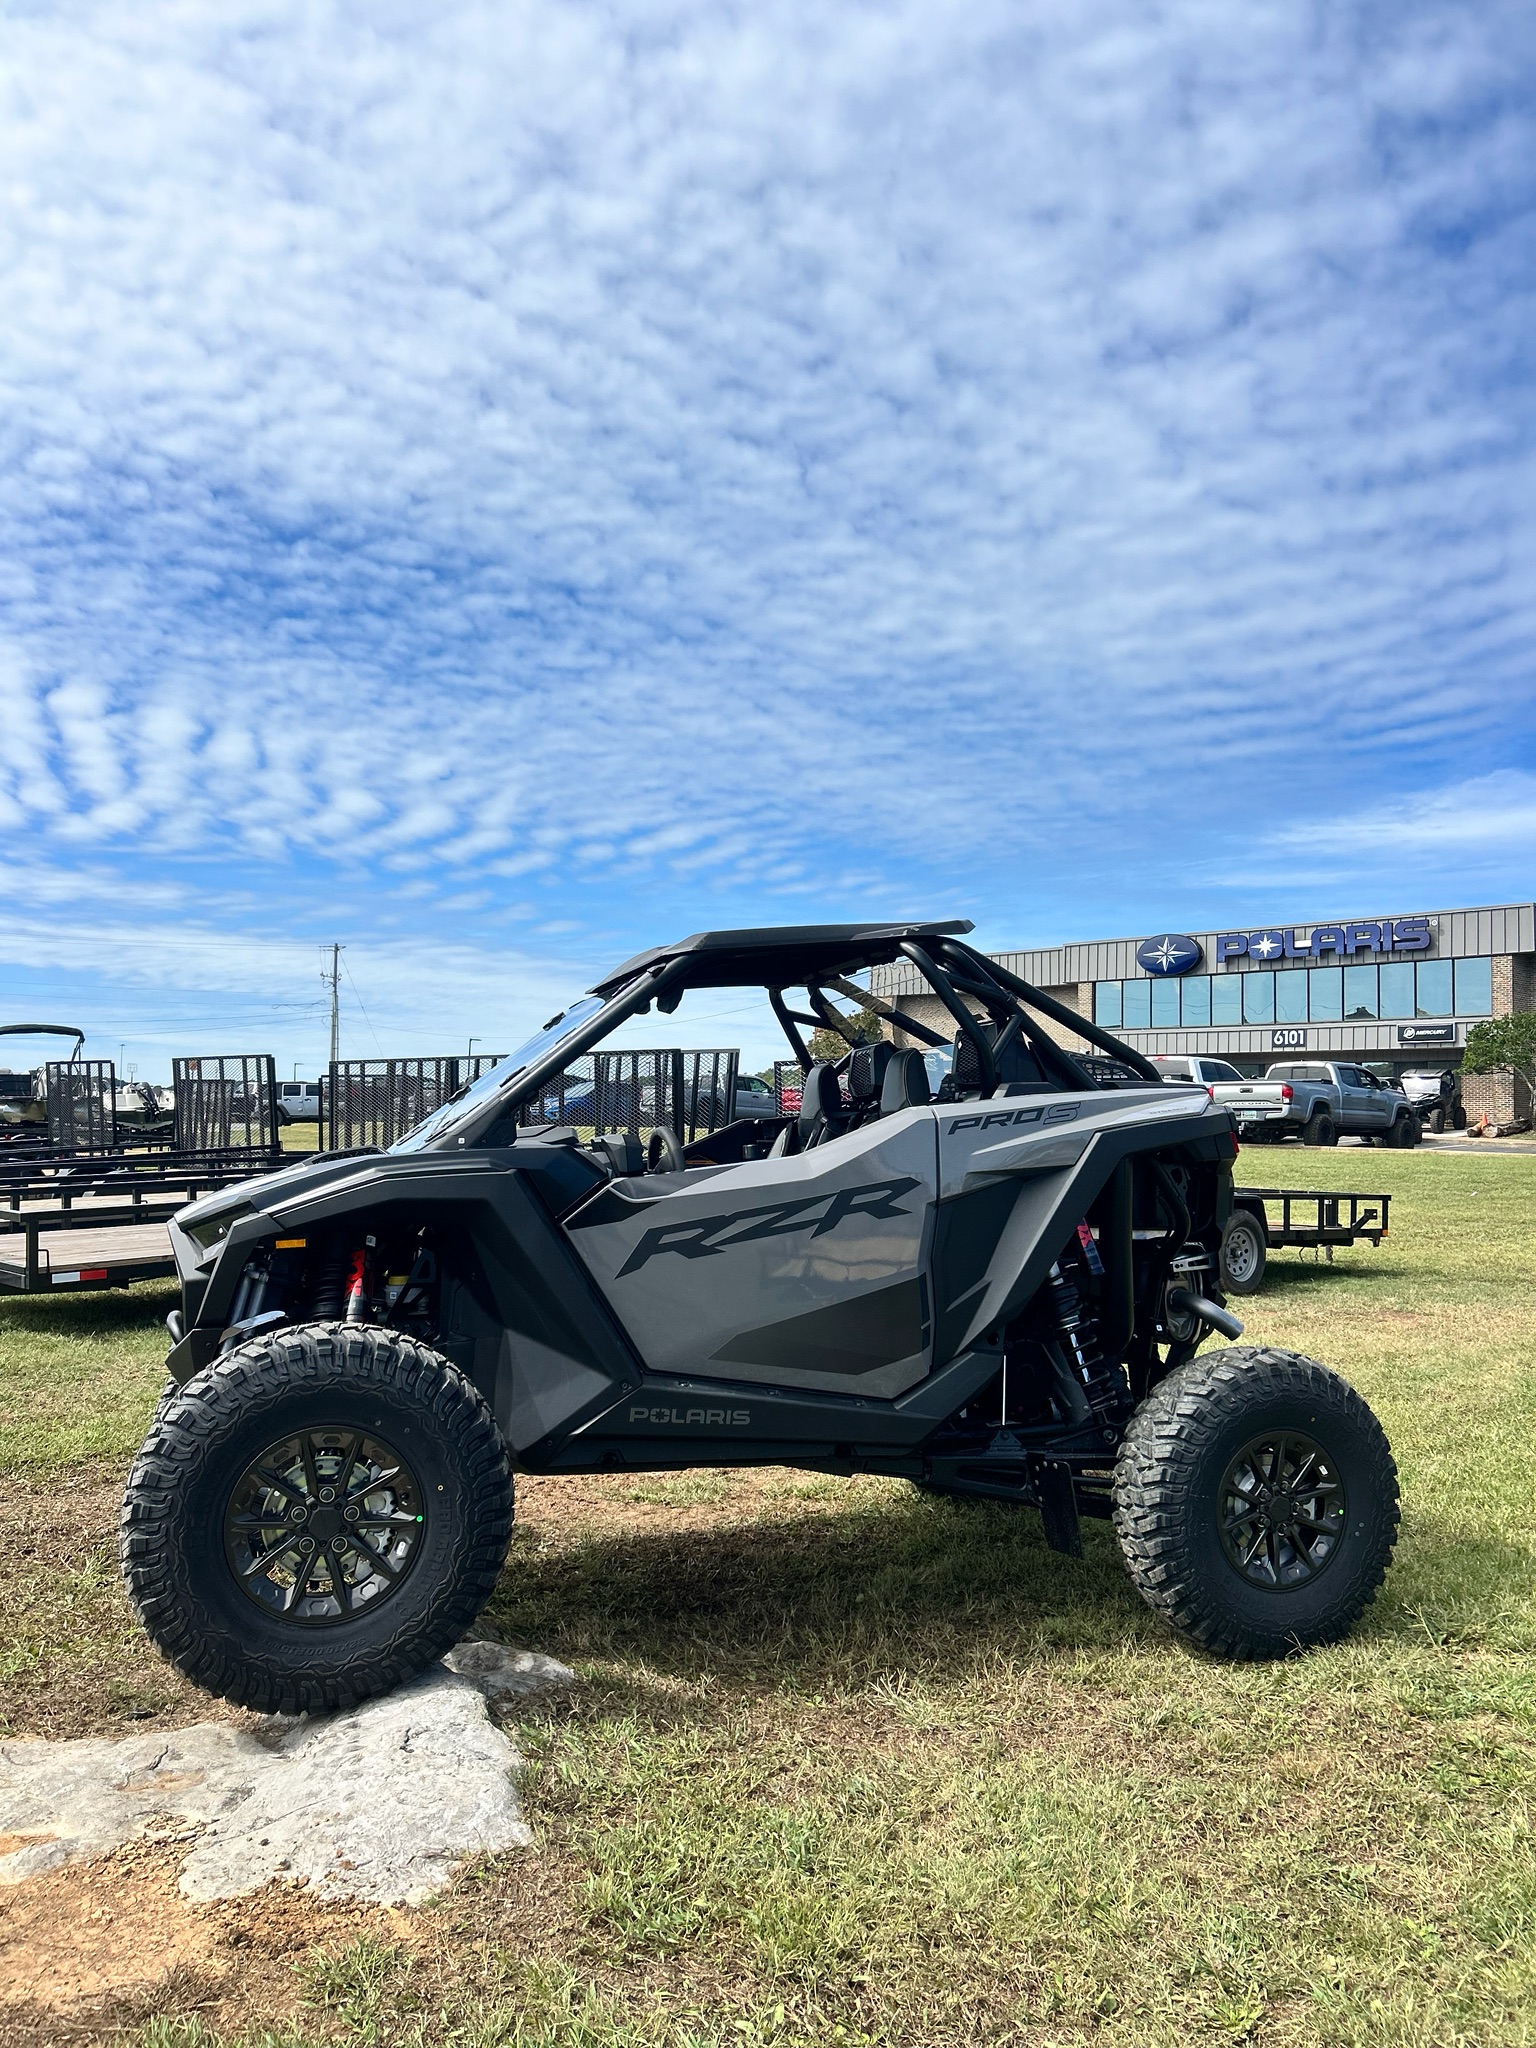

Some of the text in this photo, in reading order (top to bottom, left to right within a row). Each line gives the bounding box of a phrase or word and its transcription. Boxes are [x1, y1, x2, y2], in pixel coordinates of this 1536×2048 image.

[1217, 919, 1431, 963] POLARIS
[1274, 1031, 1304, 1045] 6101
[614, 1176, 922, 1280] RZR
[629, 1407, 751, 1425] POLARIS
